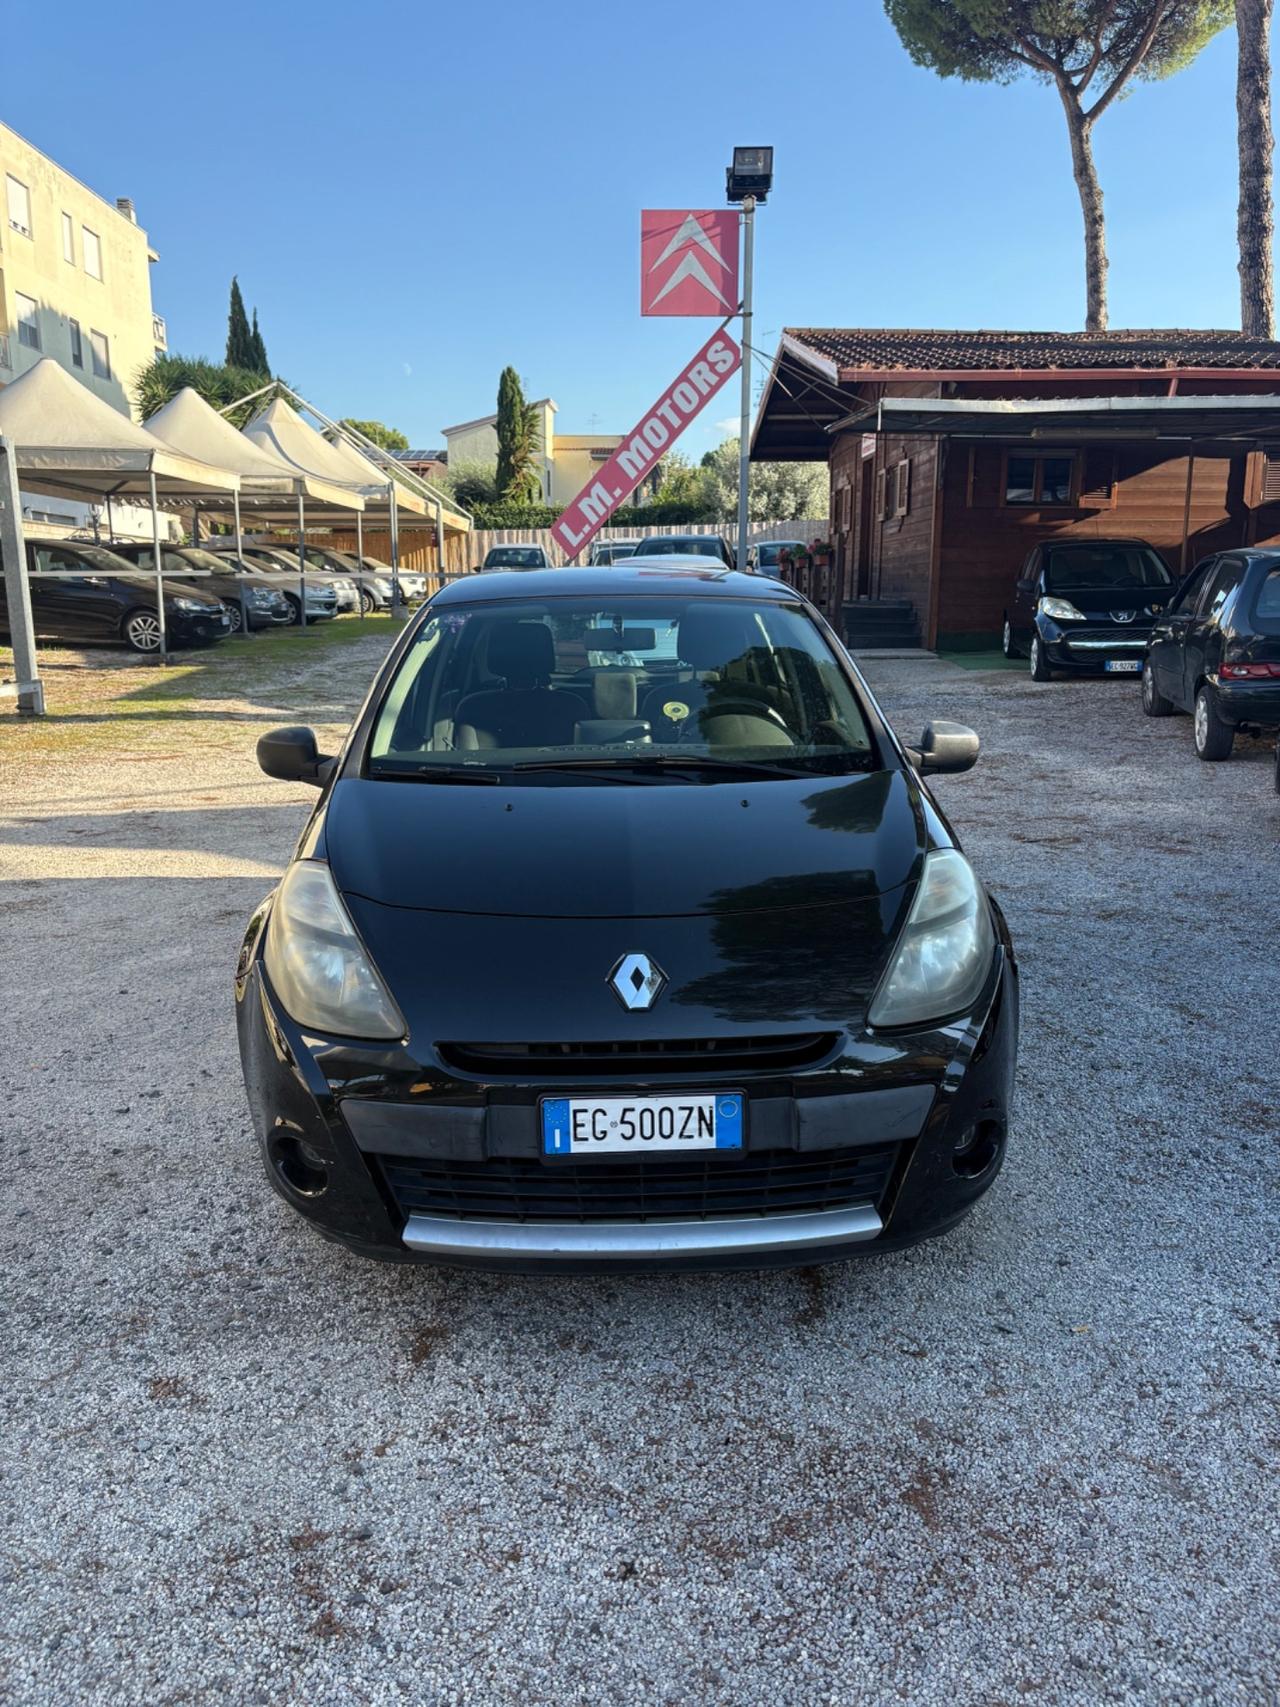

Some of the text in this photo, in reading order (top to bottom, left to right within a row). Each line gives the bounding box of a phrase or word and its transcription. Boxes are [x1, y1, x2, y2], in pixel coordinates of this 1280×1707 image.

[558, 340, 735, 548] L.M. MOTORS
[572, 1105, 714, 1142] EG 500ZN
